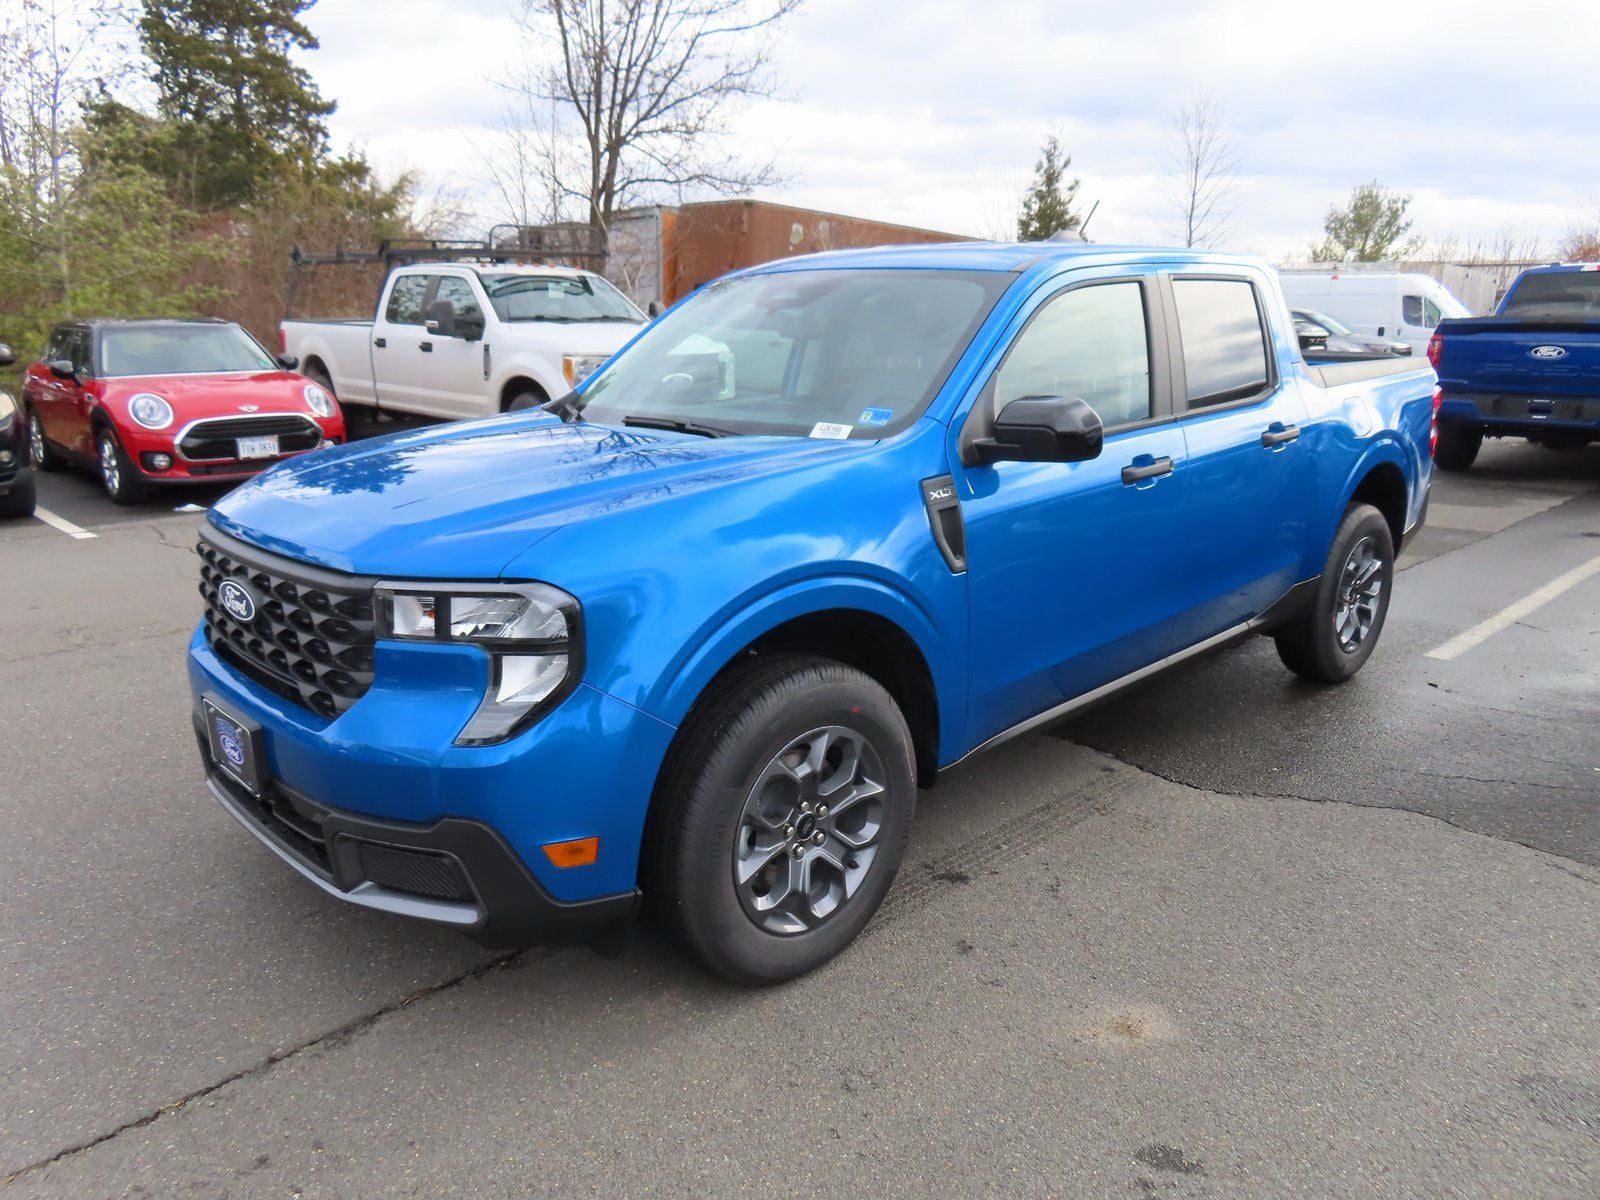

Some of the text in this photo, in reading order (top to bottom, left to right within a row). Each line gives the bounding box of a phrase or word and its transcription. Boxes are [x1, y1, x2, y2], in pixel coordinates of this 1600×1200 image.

[1537, 347, 1559, 357] Ford
[929, 488, 952, 500] XLT
[225, 586, 247, 615] Ford
